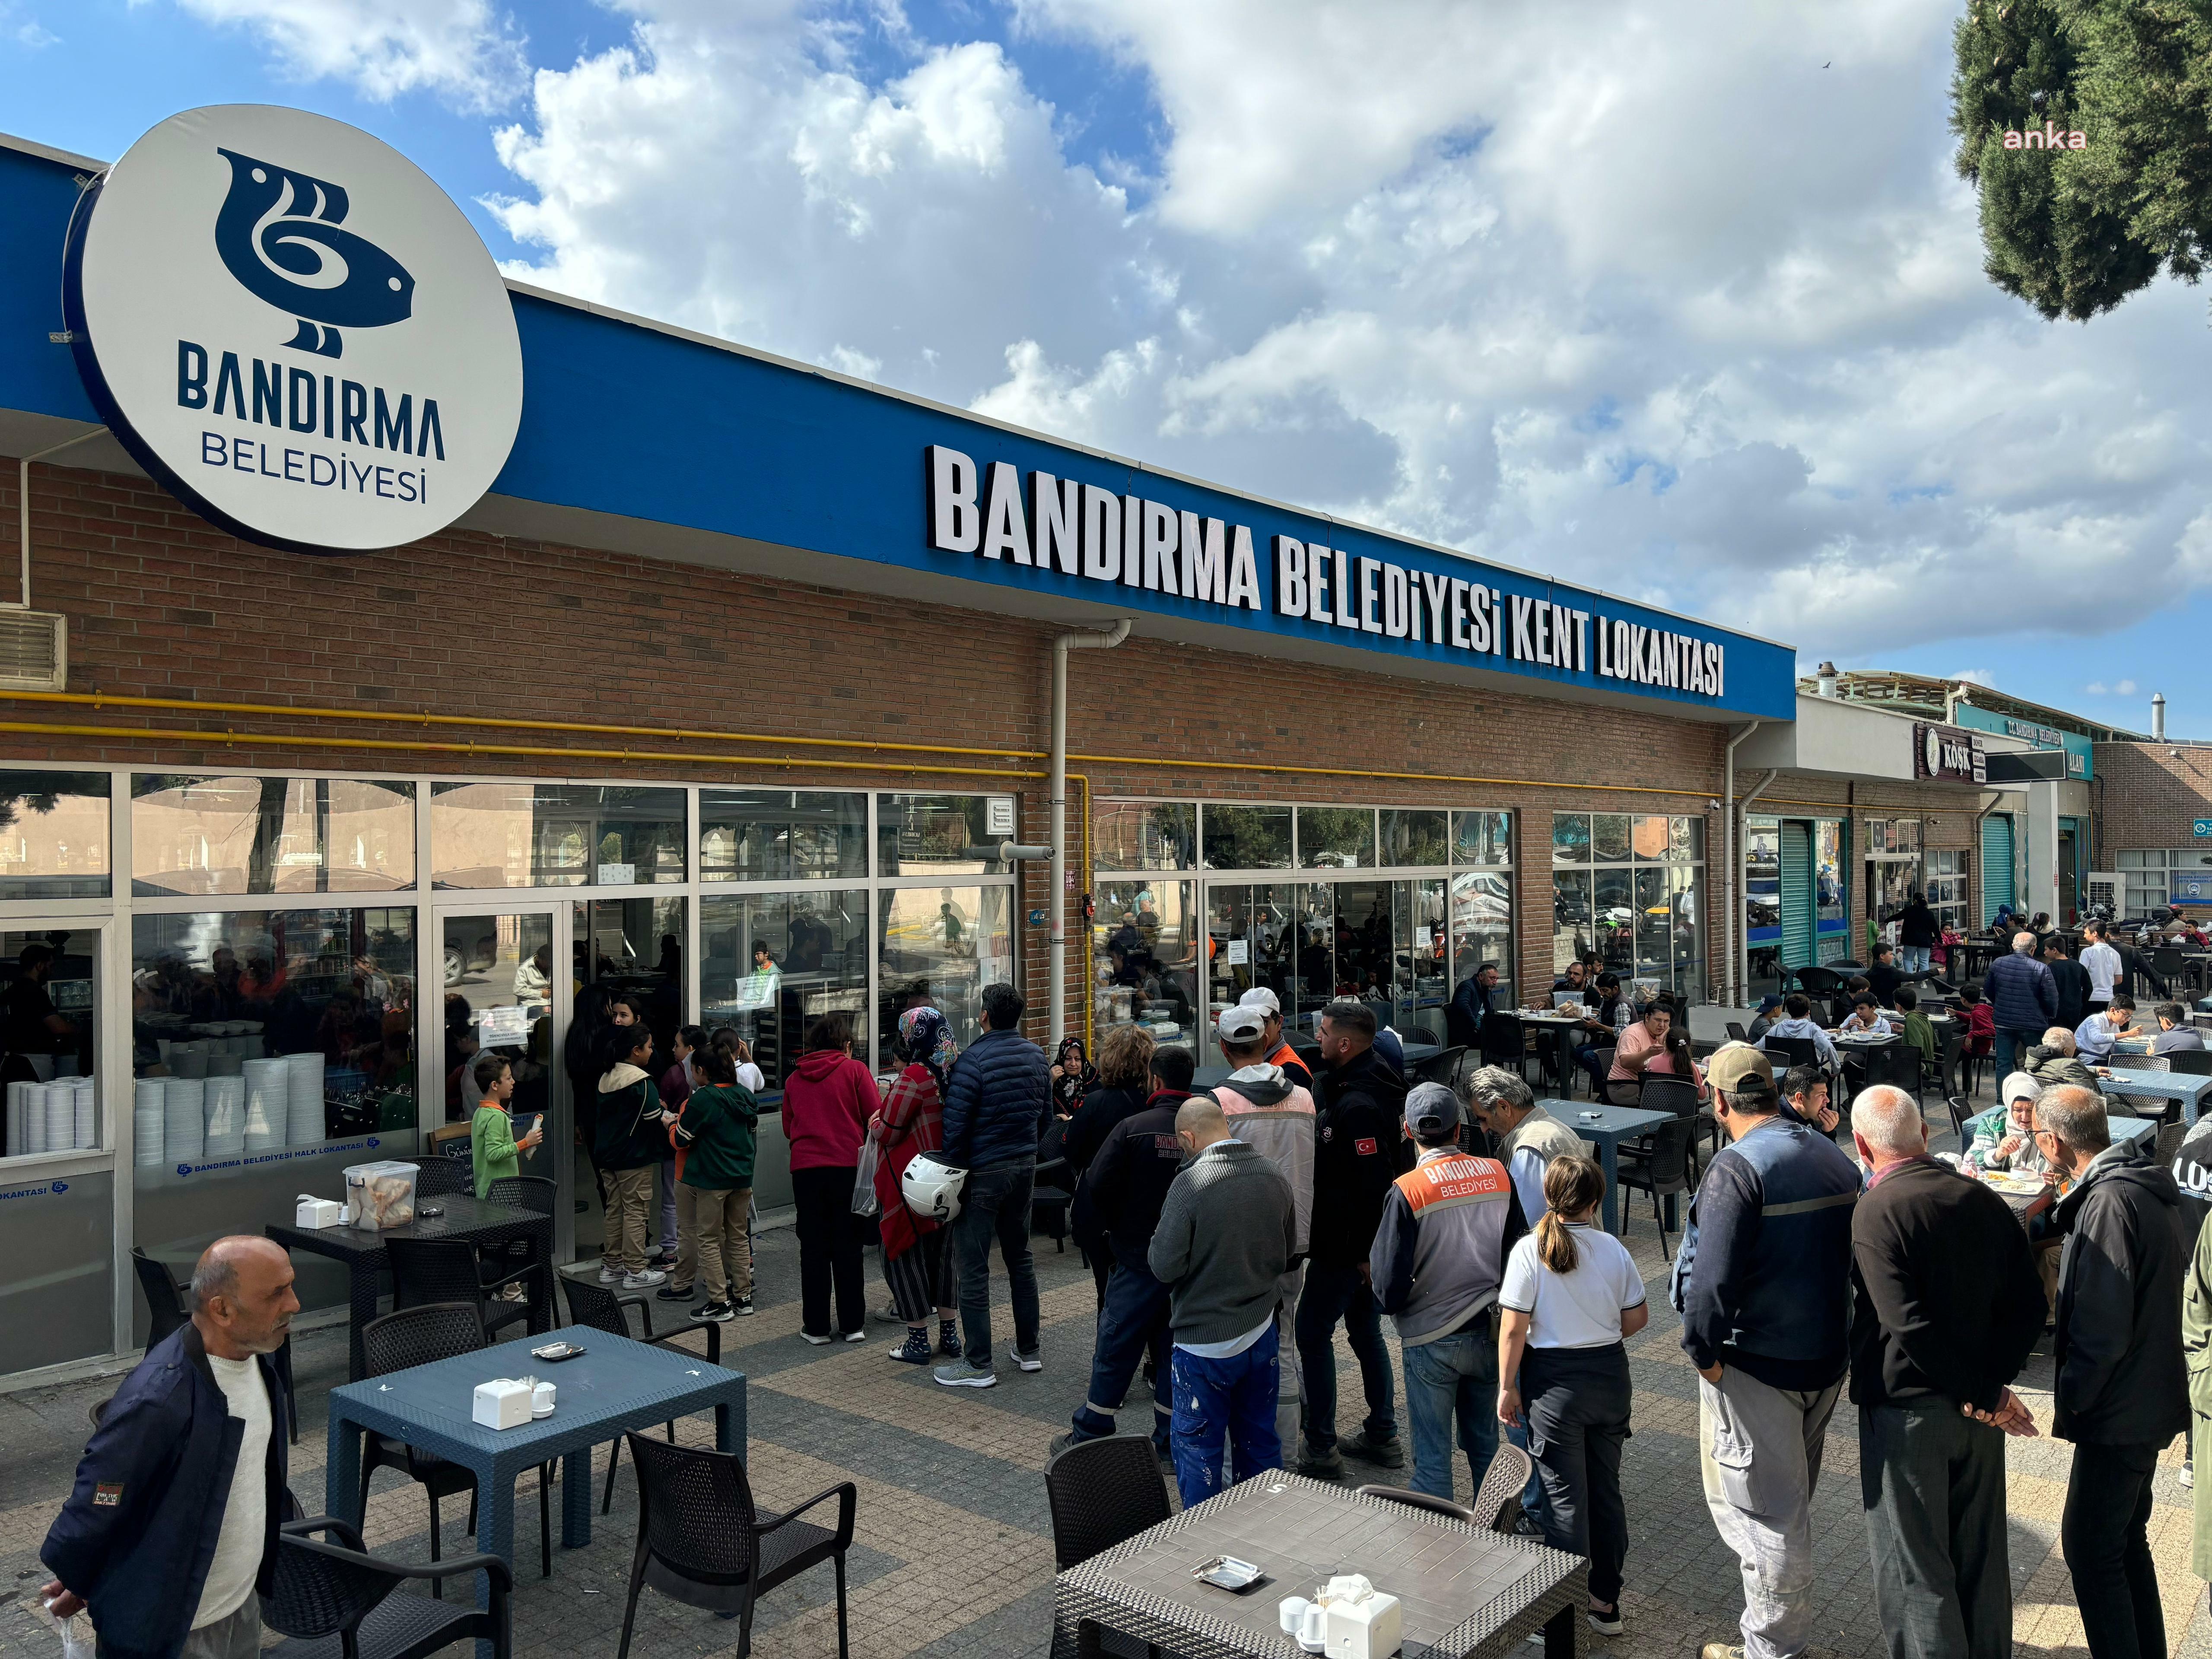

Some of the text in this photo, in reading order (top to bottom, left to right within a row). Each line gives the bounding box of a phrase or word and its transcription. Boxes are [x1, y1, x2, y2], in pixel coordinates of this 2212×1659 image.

[178, 339, 445, 461] BANDIRMA
[201, 431, 426, 504] BELEDİYESİ
[929, 444, 1724, 697] BANDIRMA BELEDİYESİ KENT LOKANTASI
[2016, 722, 2037, 740] BANDIRMA
[1944, 739, 1970, 776] KÖŞK
[2069, 753, 2085, 773] ALANI
[1155, 1135, 1181, 1149] BAND
[195, 1142, 364, 1172] BANDIRMA BELEDİYESİ HALK LOKANTASI
[1423, 1158, 1497, 1185] BANDIRMA
[0, 1188, 47, 1200] KANTASI
[1440, 1176, 1498, 1198] BELEDİYESİ
